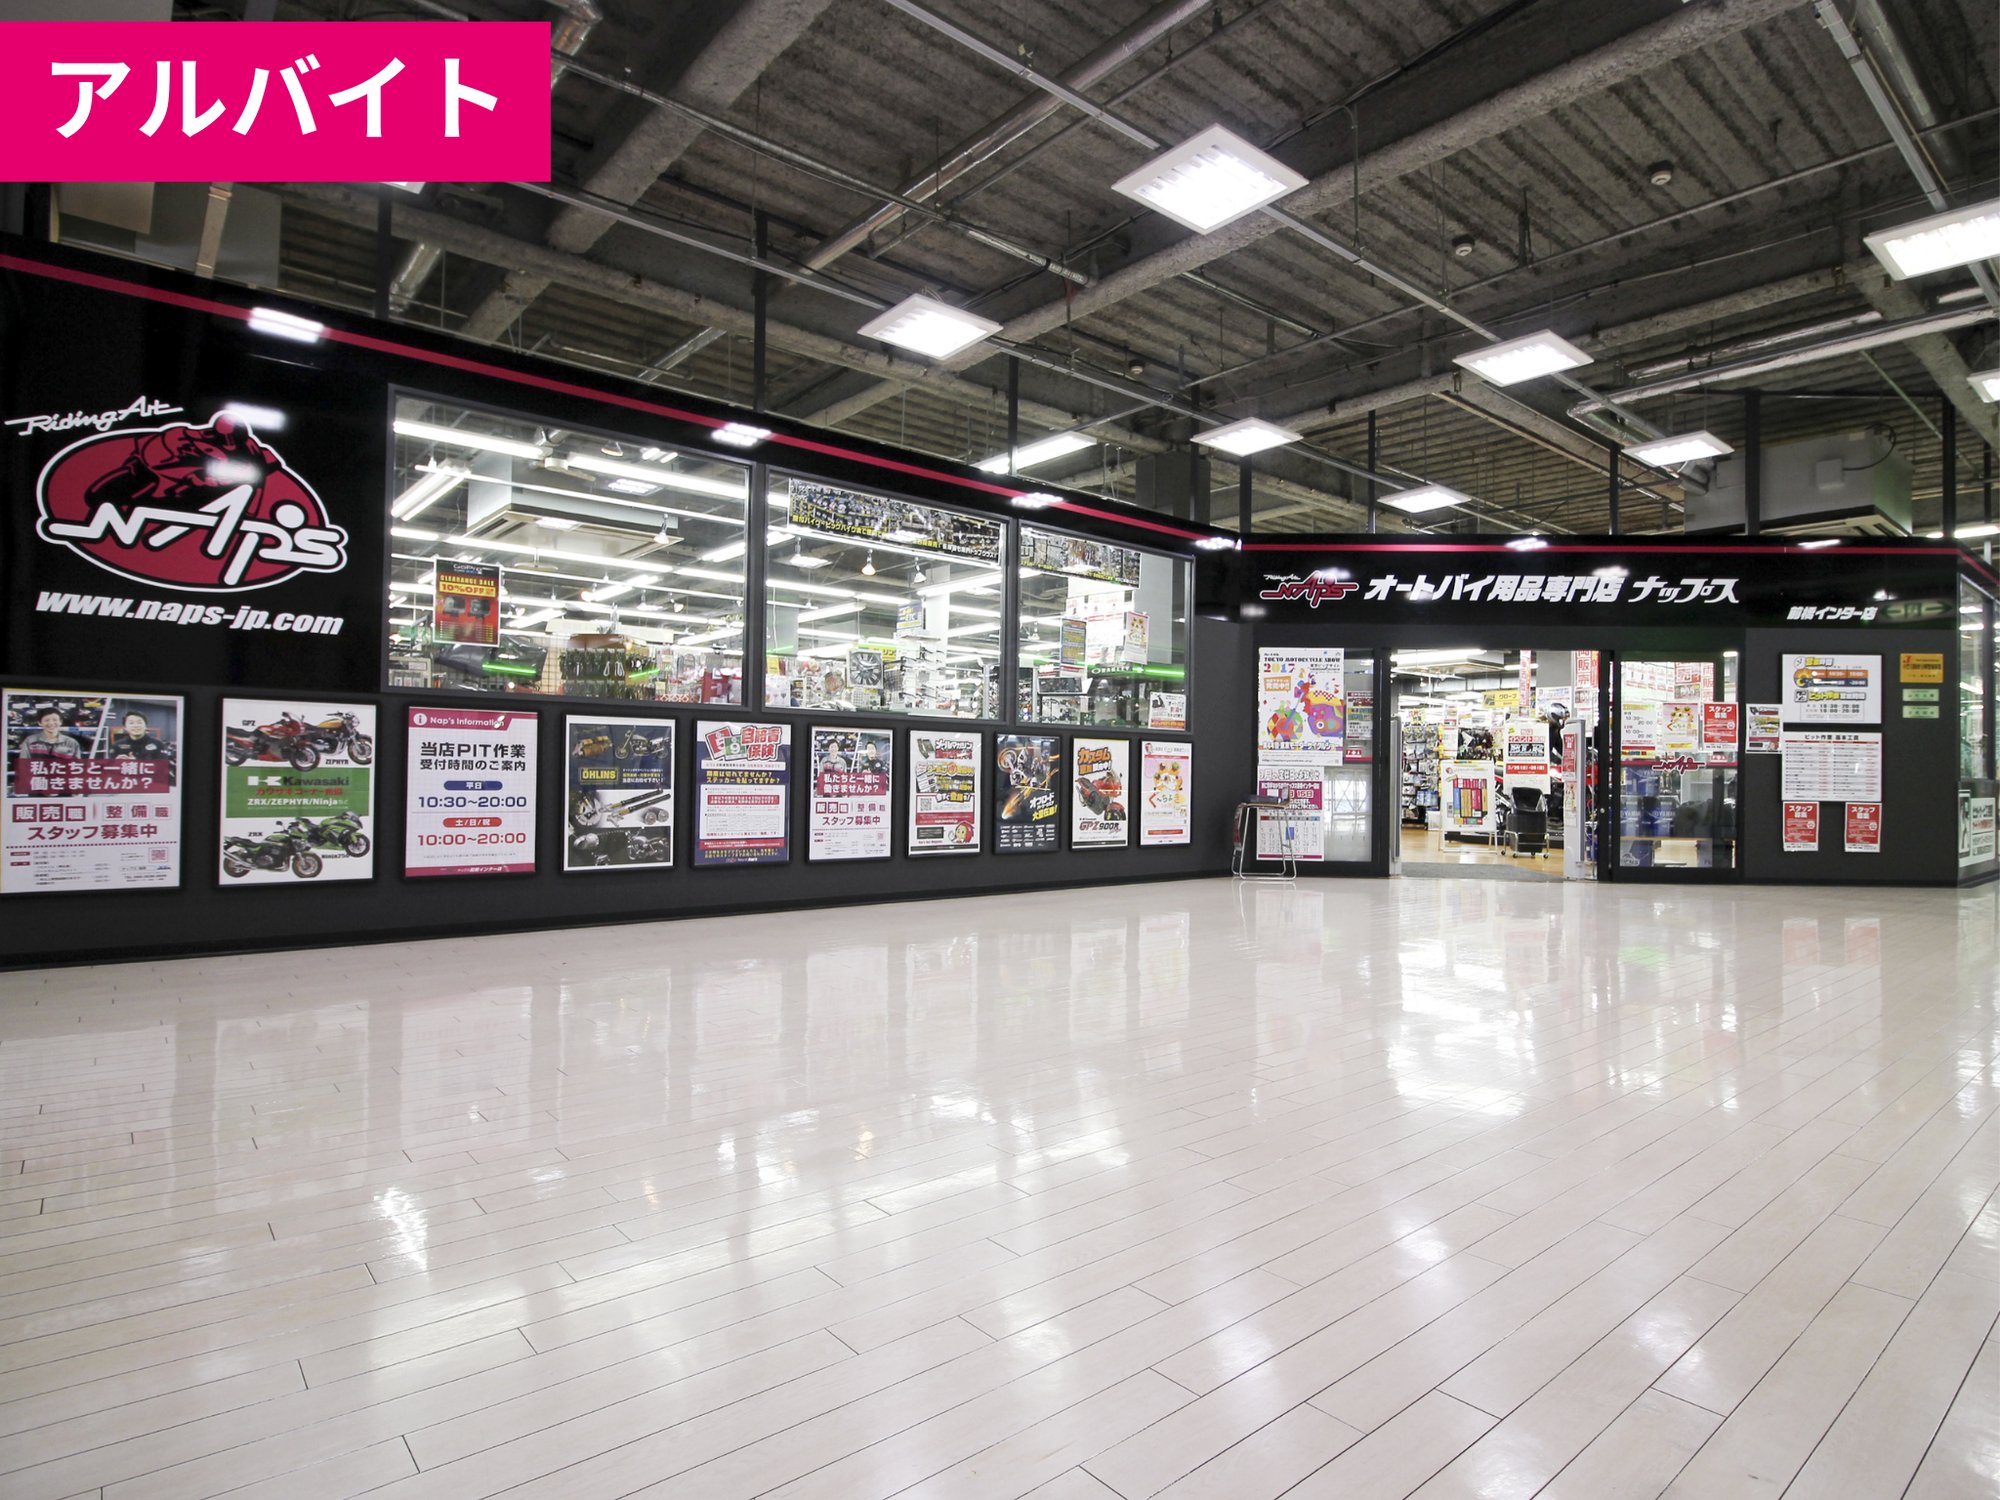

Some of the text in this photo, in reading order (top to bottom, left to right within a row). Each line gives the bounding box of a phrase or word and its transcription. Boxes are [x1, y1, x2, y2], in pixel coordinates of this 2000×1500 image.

[4, 395, 184, 436] Riding Art
[453, 563, 482, 571] GoPro
[441, 583, 485, 594] 10%OFF
[1363, 574, 1740, 604] オートバイ用品専門店 ナップス
[35, 591, 343, 636] www.naps-jp.com
[1263, 663, 1295, 673] 2017
[430, 716, 455, 727] Nap's
[740, 726, 781, 745] 自賠責
[420, 742, 526, 758] 当店PIT作業
[747, 744, 776, 759] 保険
[30, 761, 155, 775] 私たちと一緒に
[419, 759, 526, 772] 受付時間のご案内
[582, 768, 616, 779] ÖHLINS
[823, 774, 880, 783] 私たちと一緒に
[30, 776, 153, 790] 働きませんか？
[283, 776, 350, 786] Kawasaki
[823, 784, 879, 793] 働きませんか？
[14, 804, 170, 822] 販売職 整備職
[822, 815, 881, 826] スタッフ募集中
[28, 824, 158, 841] スタッフ募集中
